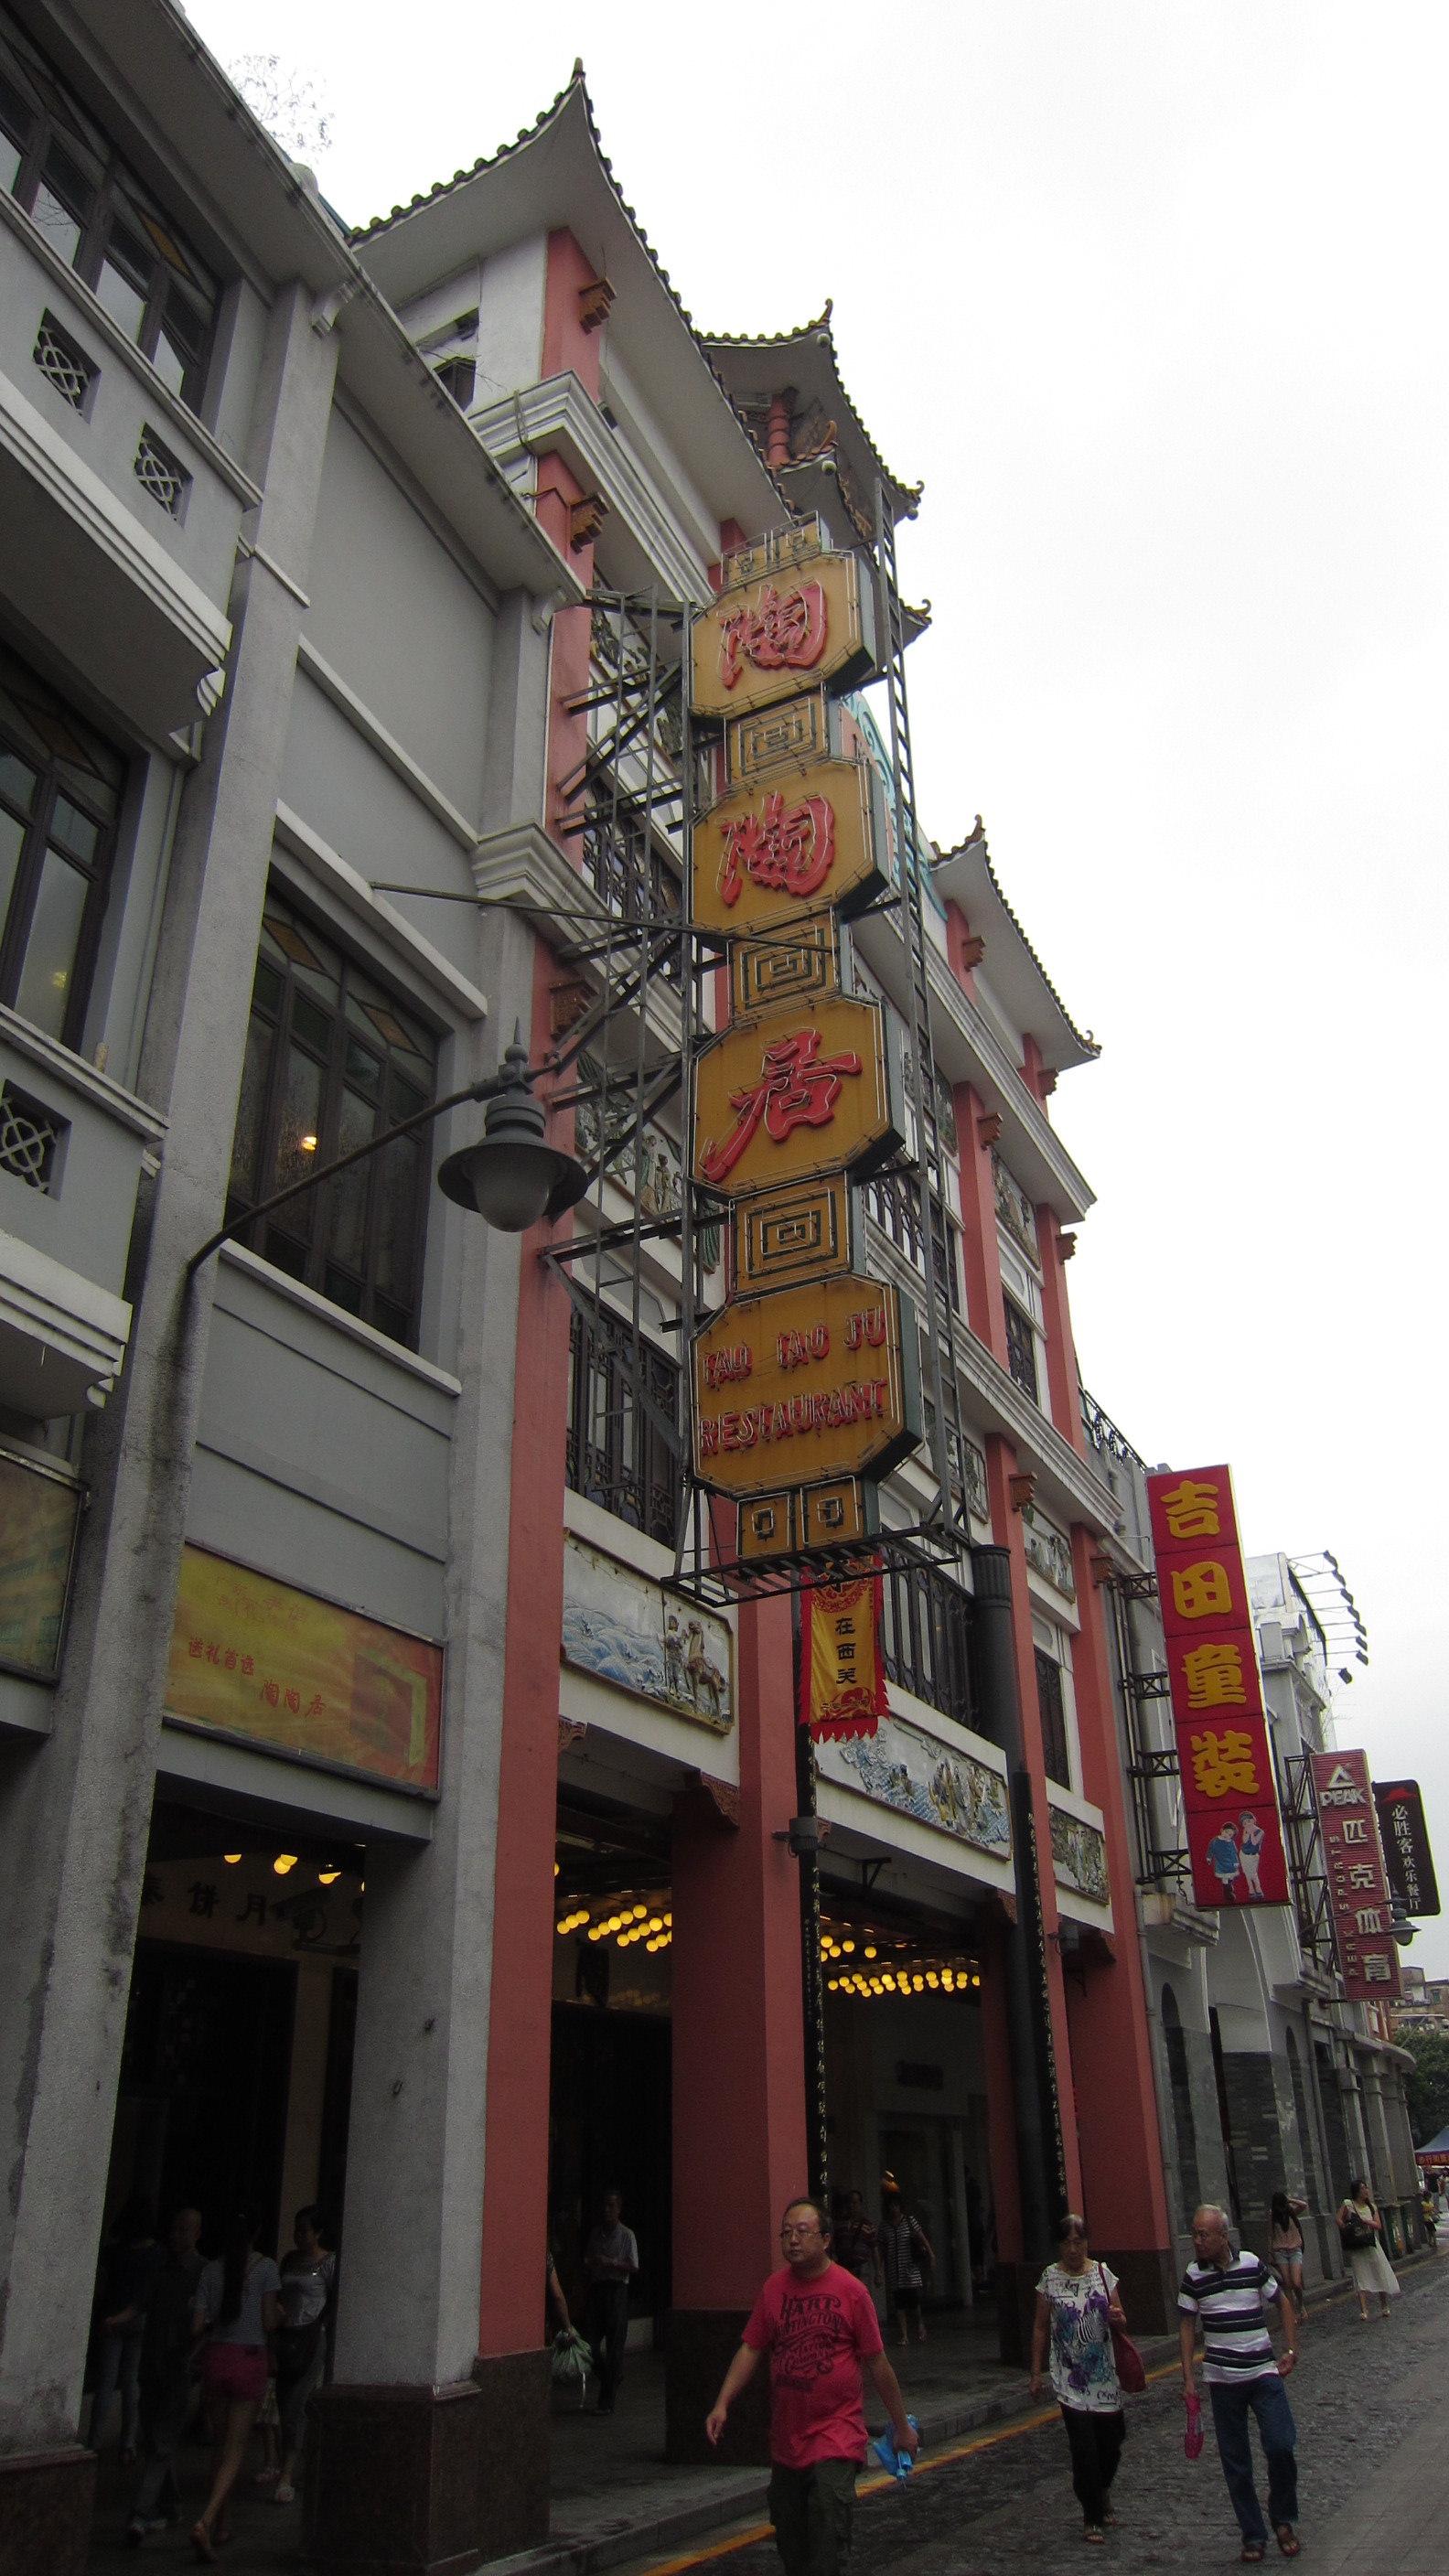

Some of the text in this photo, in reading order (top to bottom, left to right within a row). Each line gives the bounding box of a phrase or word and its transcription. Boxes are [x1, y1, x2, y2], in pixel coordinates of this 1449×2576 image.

[703, 576, 862, 1184] 陶陶居
[843, 1305, 886, 1350] JU
[700, 1377, 887, 1455] RESTAURANT
[188, 1636, 255, 1676] 送礼首选
[261, 1679, 327, 1721] 陶陶居
[1319, 1787, 1368, 1809] PEAK
[1342, 1819, 1392, 1983] 匹克体育
[780, 2293, 841, 2321] HART
